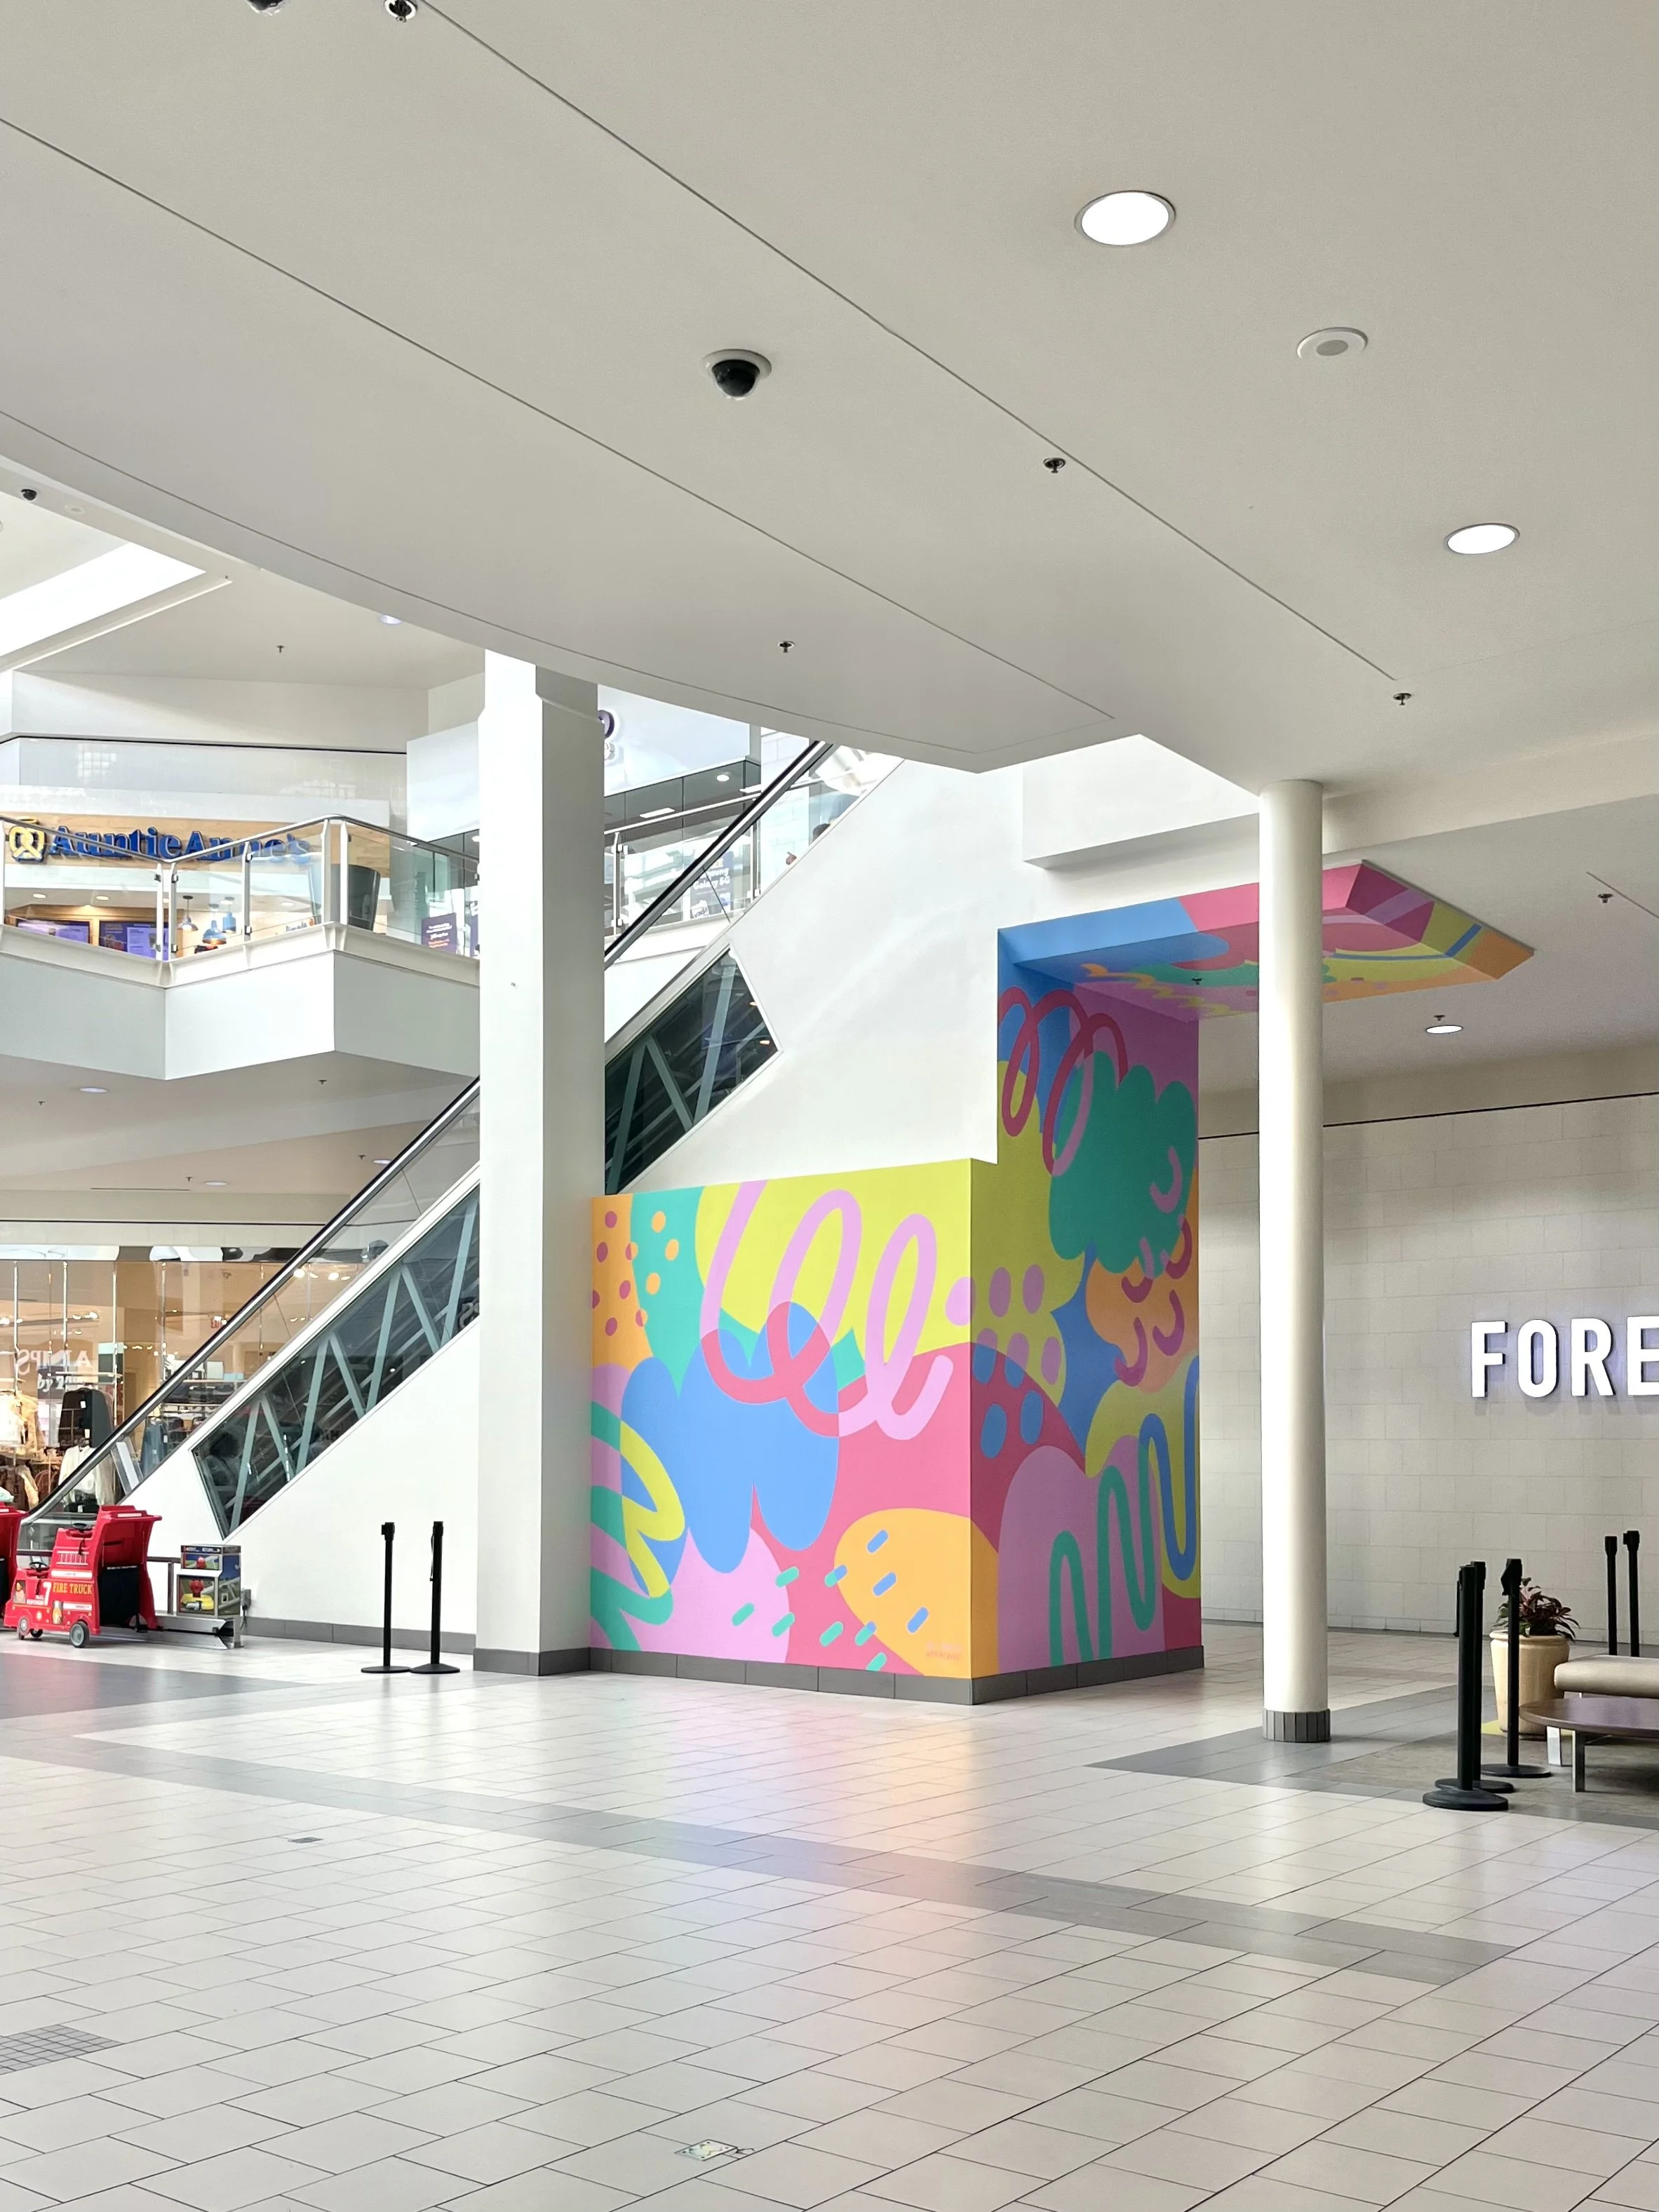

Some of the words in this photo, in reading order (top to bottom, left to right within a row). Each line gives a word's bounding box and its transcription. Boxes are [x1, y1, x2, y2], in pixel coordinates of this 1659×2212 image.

[48, 825, 182, 858] Auntie
[1472, 1316, 1659, 1398] FORE
[43, 1582, 52, 1606] 7
[53, 1582, 68, 1593] FIRE
[69, 1583, 92, 1594] TRUCK
